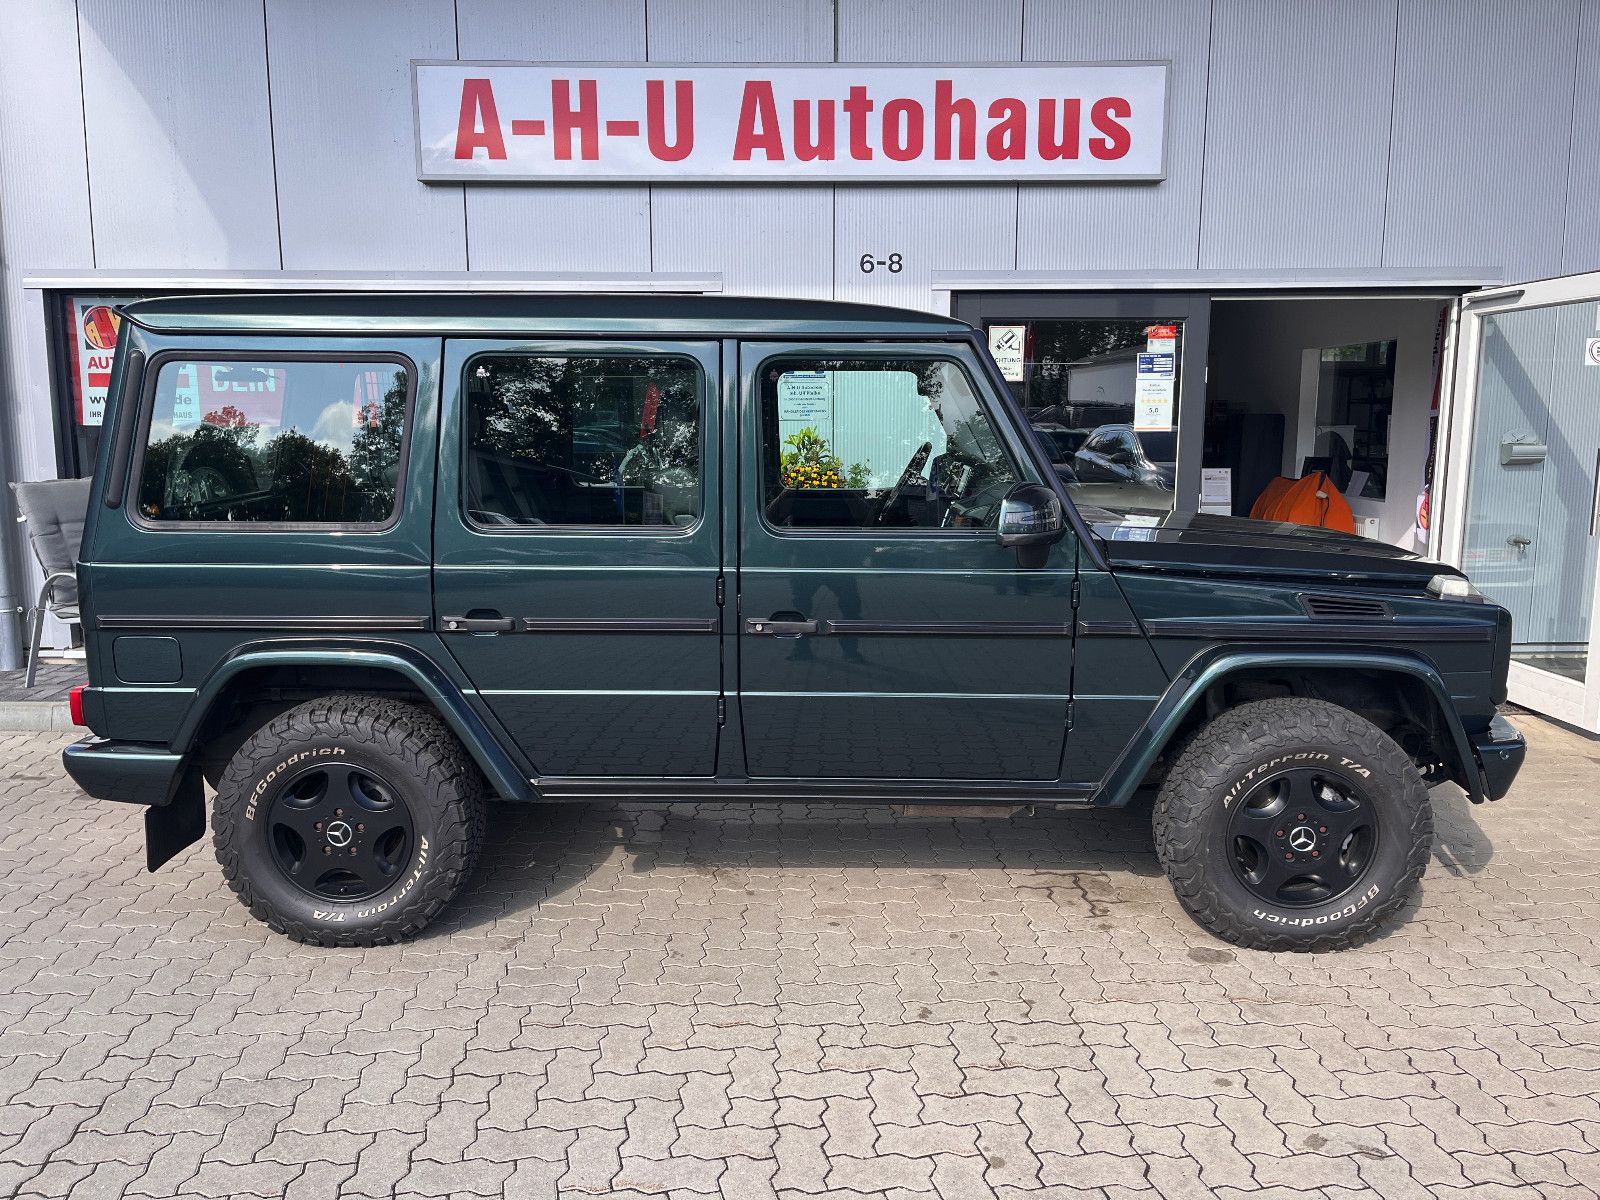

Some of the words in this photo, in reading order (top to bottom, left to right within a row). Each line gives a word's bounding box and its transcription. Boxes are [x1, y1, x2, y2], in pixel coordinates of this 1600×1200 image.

[454, 78, 694, 161] A-H-U
[732, 79, 1132, 161] Autohaus
[859, 253, 904, 274] 6-8
[245, 747, 346, 821] BFGoodrich
[1223, 752, 1329, 809] All-Terrain
[1338, 756, 1372, 779] T/A
[357, 835, 429, 918] All-Terrain
[312, 909, 346, 922] T/A
[1253, 884, 1380, 928] BFGoodrich
